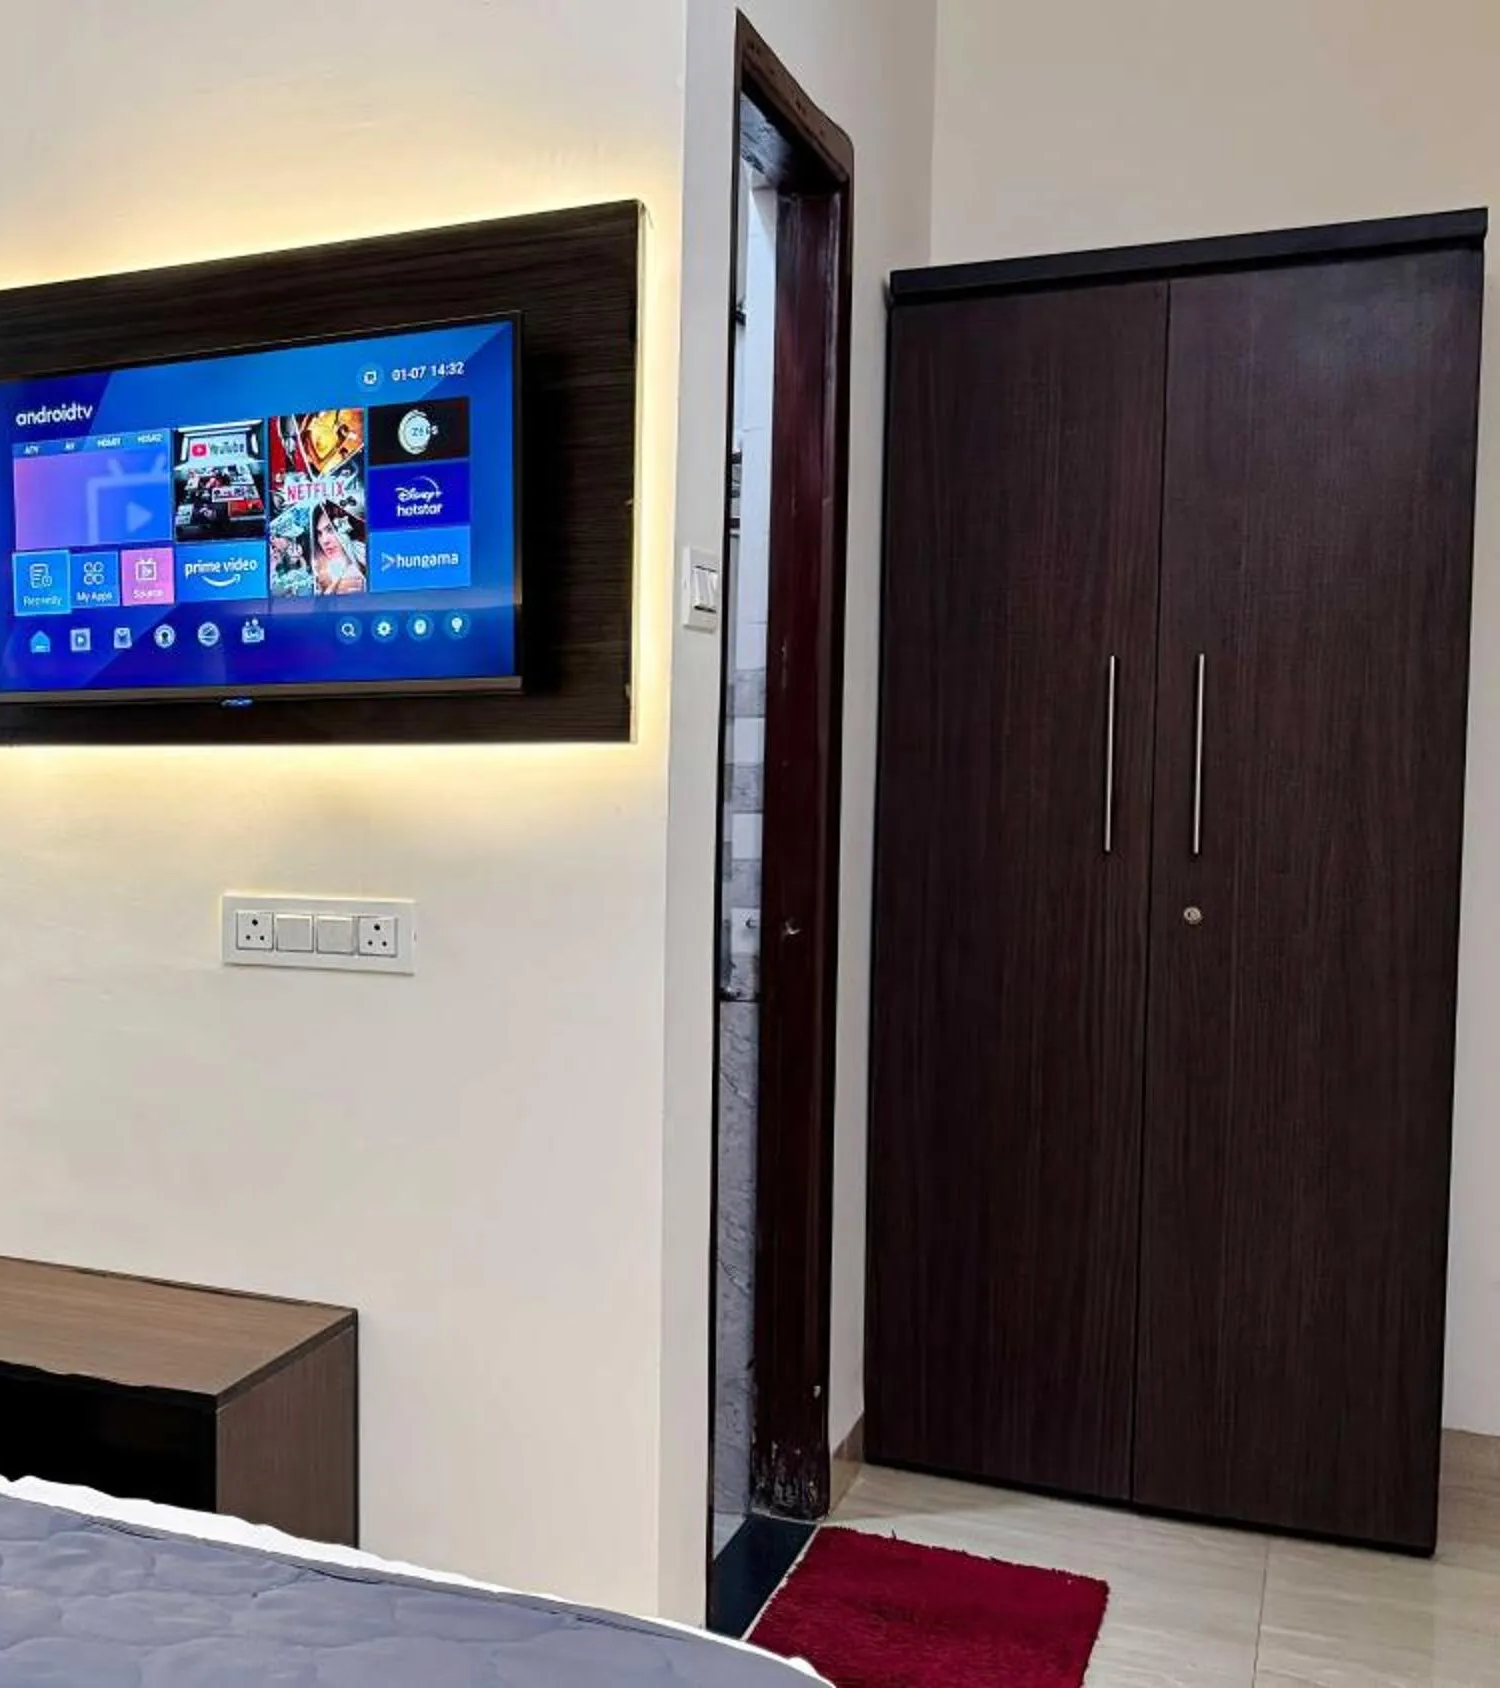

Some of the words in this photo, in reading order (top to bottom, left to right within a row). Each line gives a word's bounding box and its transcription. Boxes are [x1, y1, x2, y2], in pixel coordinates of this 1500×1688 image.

[392, 366, 427, 381] 01-07
[431, 361, 465, 377] 14:32
[15, 401, 93, 426] androidtv
[286, 480, 345, 502] NETFLIX
[396, 503, 443, 517] hotstar
[184, 560, 221, 580] prime
[223, 557, 258, 572] video
[396, 553, 459, 569] hungama
